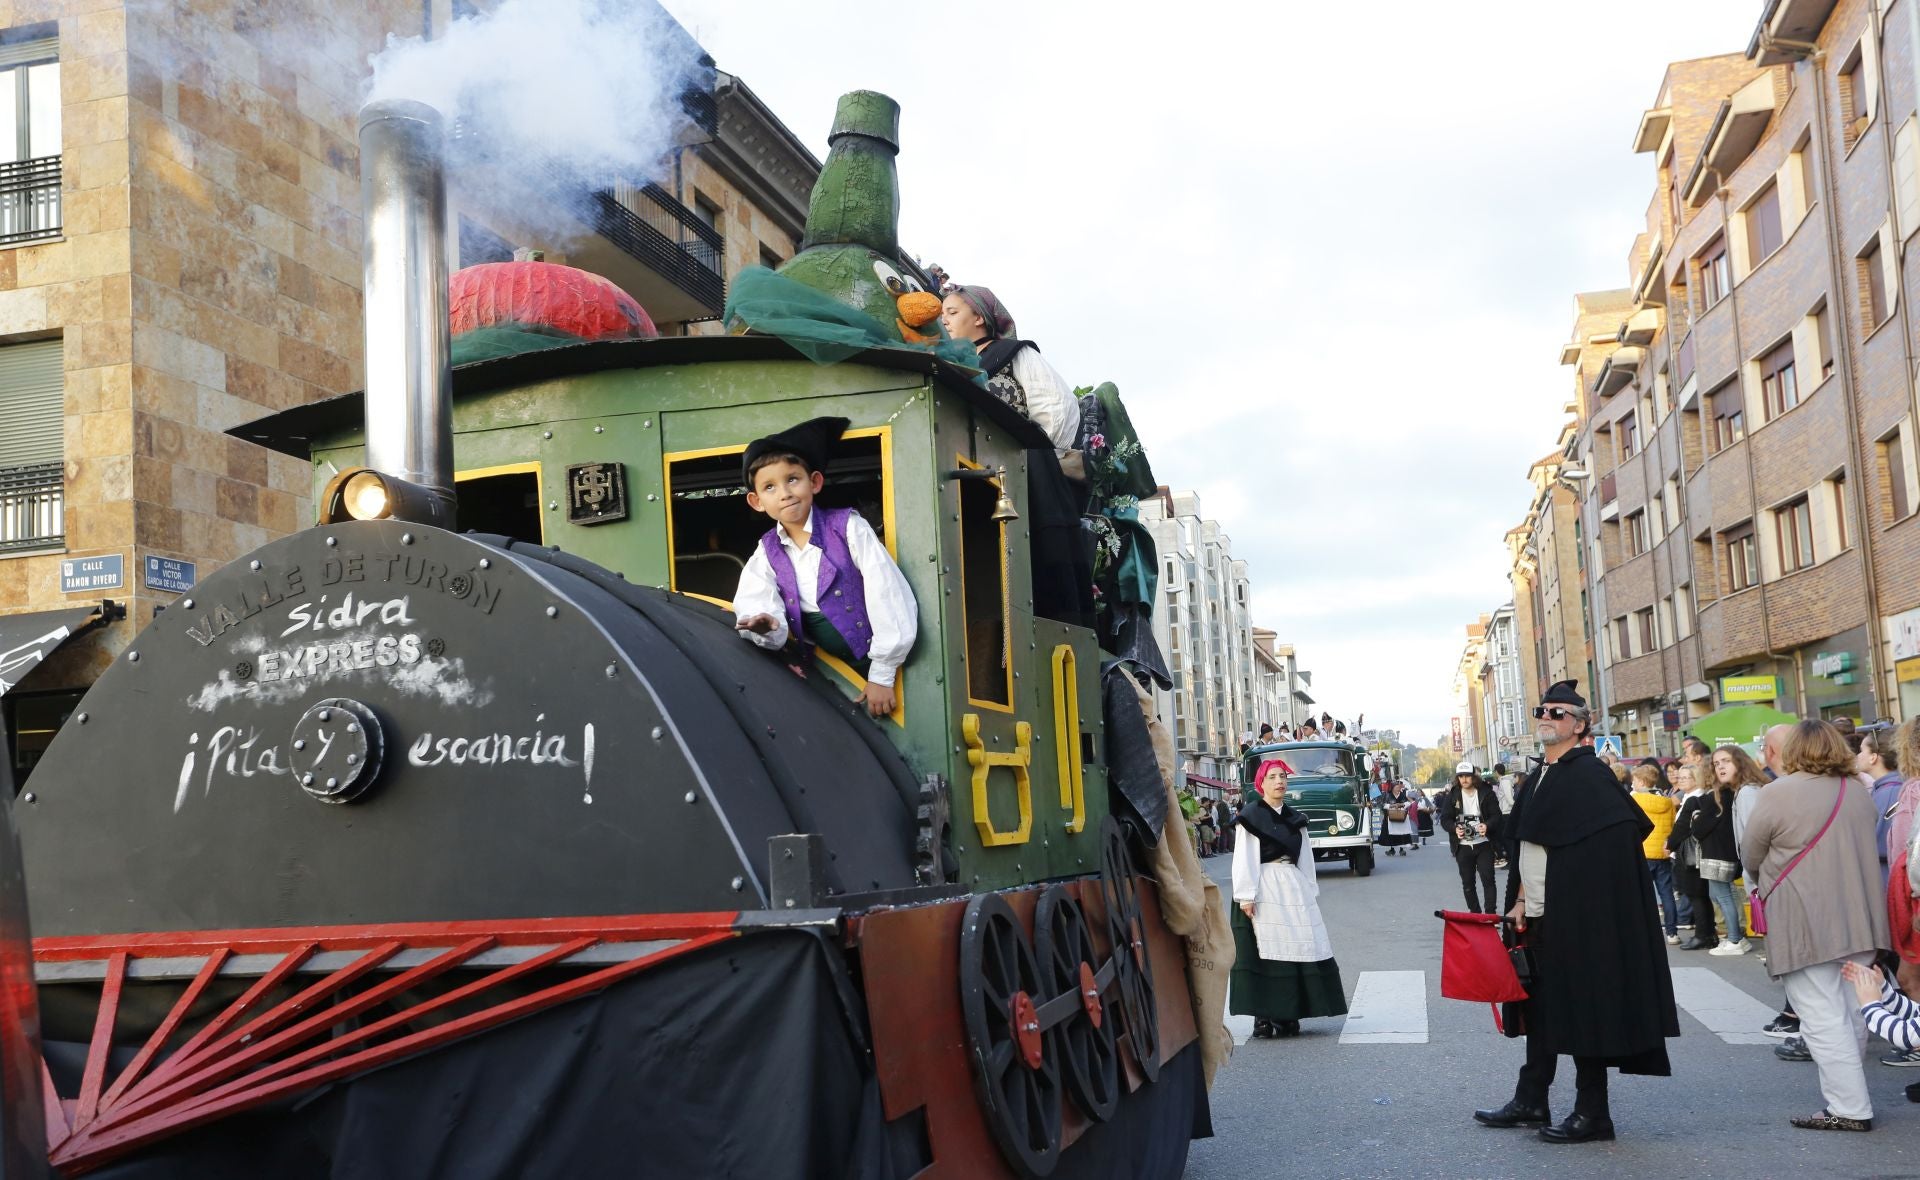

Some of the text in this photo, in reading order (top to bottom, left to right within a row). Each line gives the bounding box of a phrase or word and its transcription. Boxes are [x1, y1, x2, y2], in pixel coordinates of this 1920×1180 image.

[82, 561, 104, 571] CALLE
[163, 561, 181, 570] CALLE
[92, 573, 117, 586] RIVERO
[162, 569, 182, 580] VICTOR
[163, 579, 170, 588] DE
[170, 580, 176, 589] LA
[185, 566, 306, 647] VALLE
[321, 554, 366, 587] DE
[258, 633, 422, 682] EXPRESS
[1452, 718, 1462, 747] HOTEL
